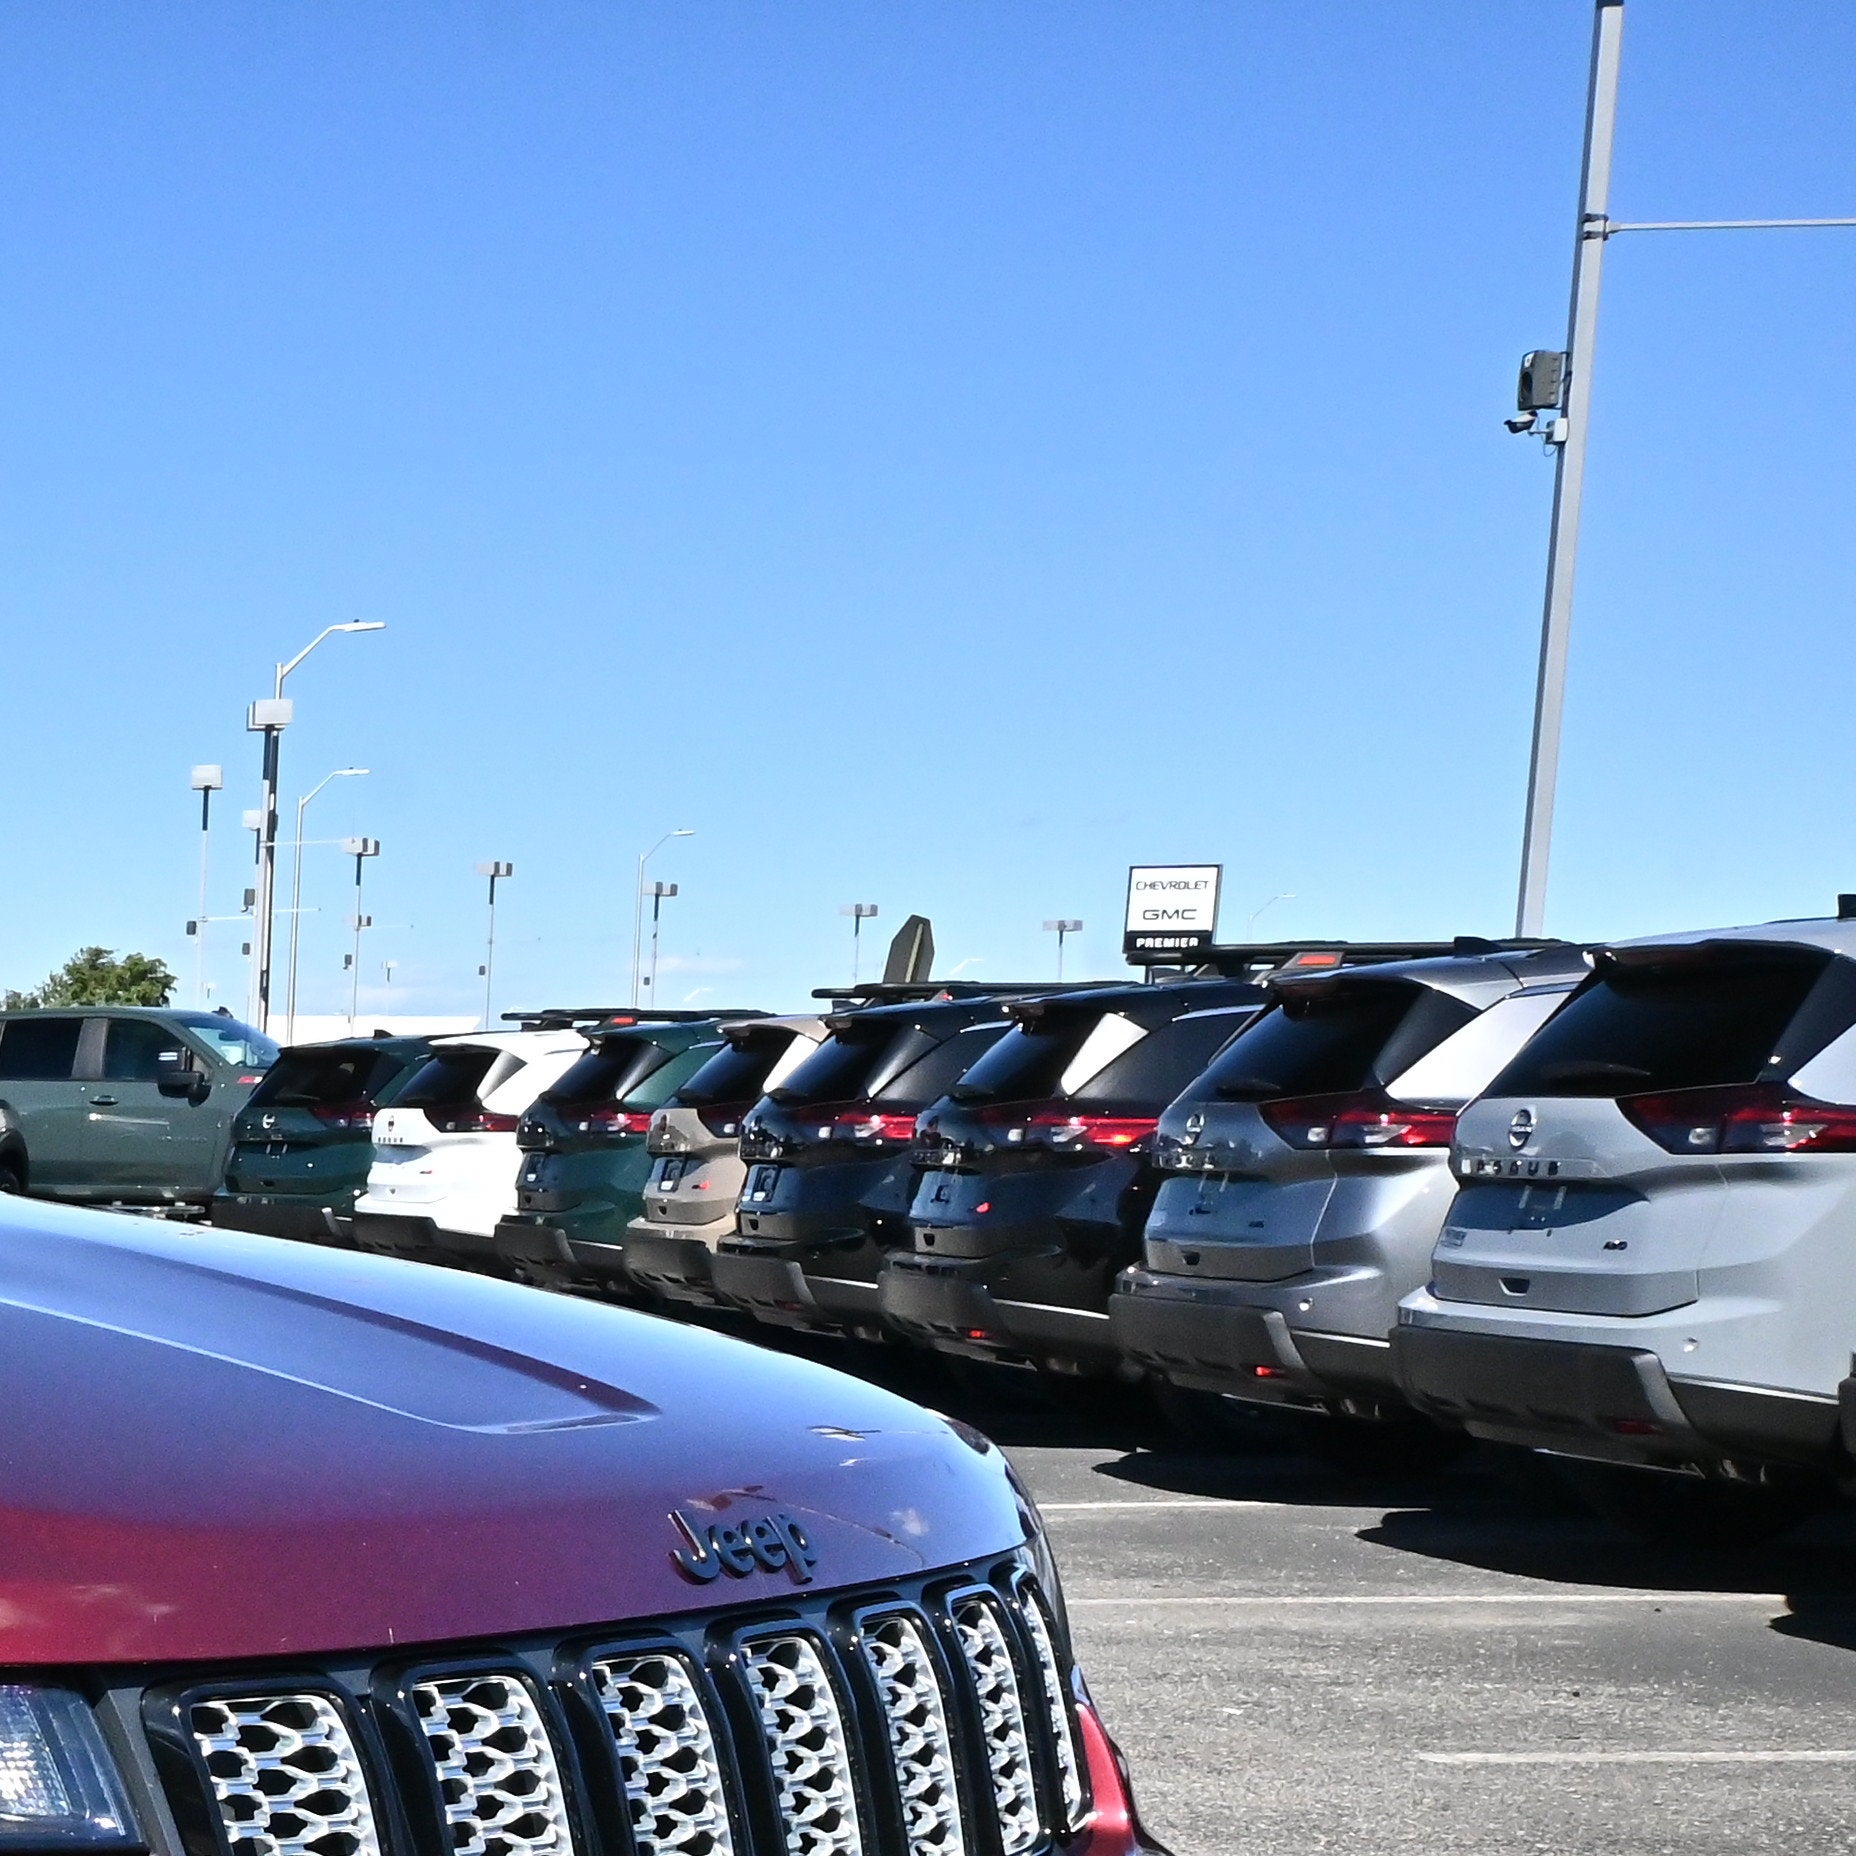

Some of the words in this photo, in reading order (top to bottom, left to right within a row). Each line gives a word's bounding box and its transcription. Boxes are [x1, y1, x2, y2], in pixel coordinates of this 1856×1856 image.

[1136, 881, 1208, 890] CHEVROLET
[1142, 908, 1197, 920] GMC
[1136, 937, 1199, 948] PREMIER
[667, 1509, 816, 1586] Jeep
